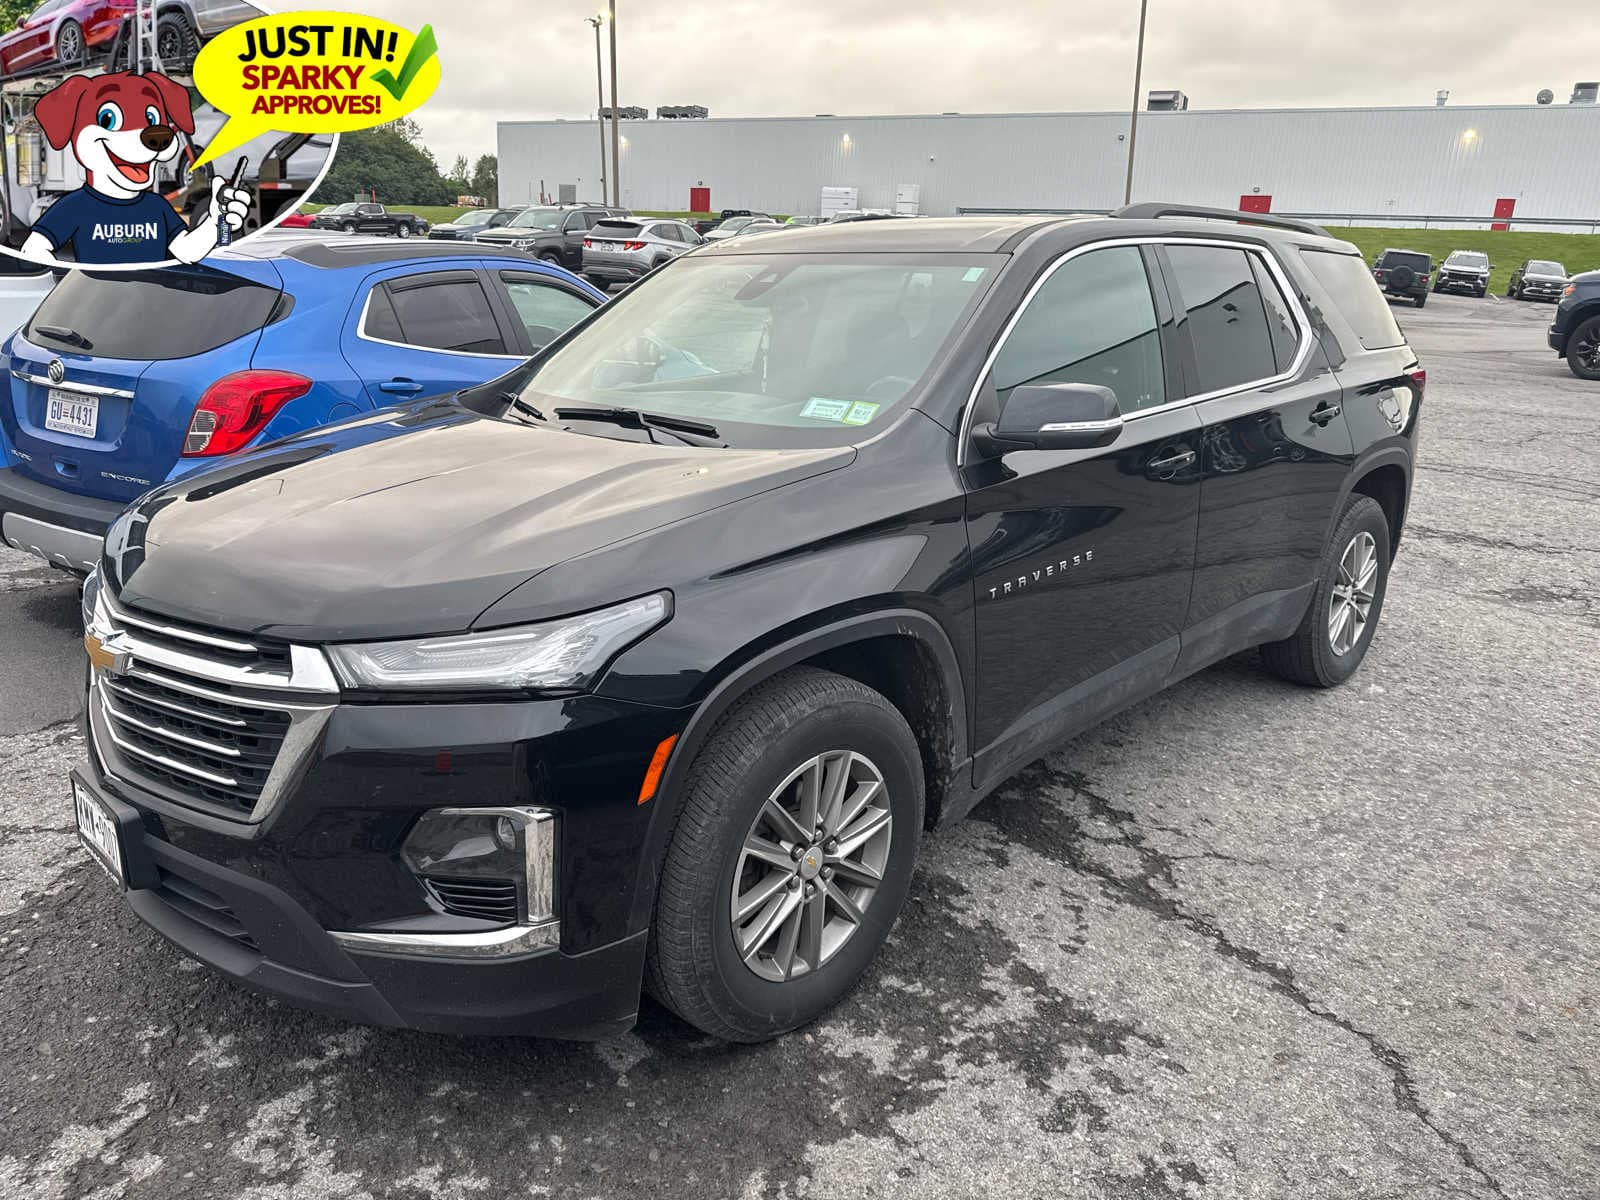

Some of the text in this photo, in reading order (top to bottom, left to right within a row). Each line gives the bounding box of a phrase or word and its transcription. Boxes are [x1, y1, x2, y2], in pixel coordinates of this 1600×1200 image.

[69, 404, 93, 427] 4431
[101, 471, 151, 486] ENCORE
[989, 550, 1094, 599] TRAVERSE
